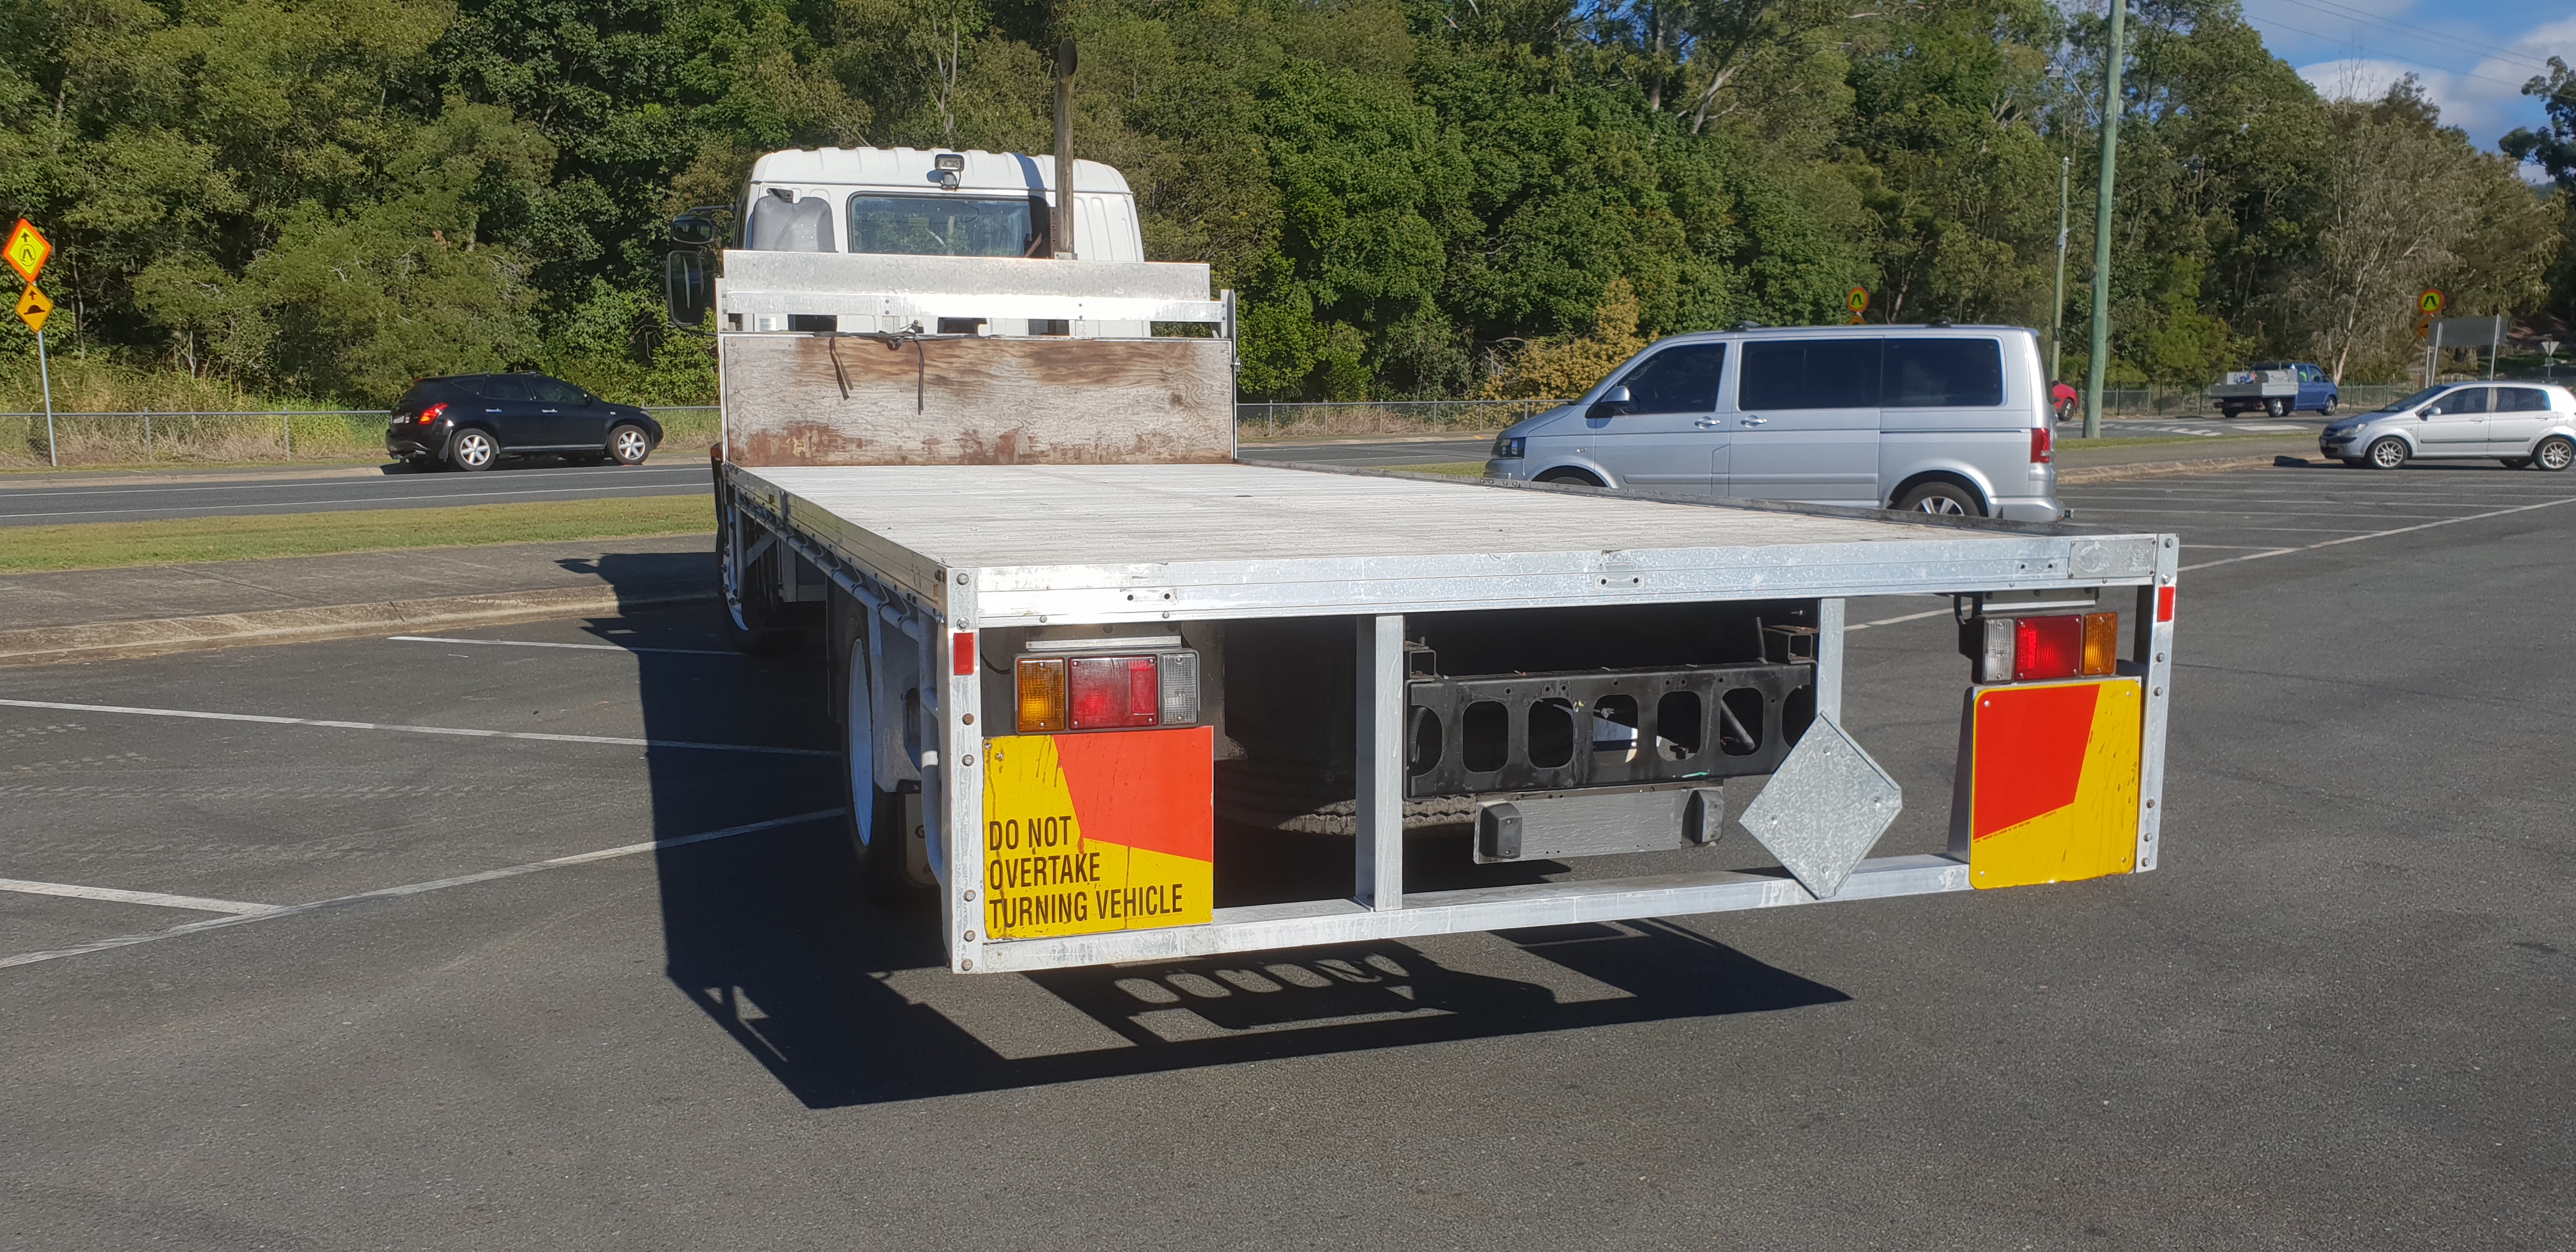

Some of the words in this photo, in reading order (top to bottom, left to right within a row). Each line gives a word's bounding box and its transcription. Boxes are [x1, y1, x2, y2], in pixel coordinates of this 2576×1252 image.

[989, 819, 1020, 851] DO
[1028, 815, 1071, 848] NOT
[990, 852, 1101, 890] OVERTAKE
[989, 891, 1087, 929] TURNING
[1096, 883, 1183, 920] VEHICLE
